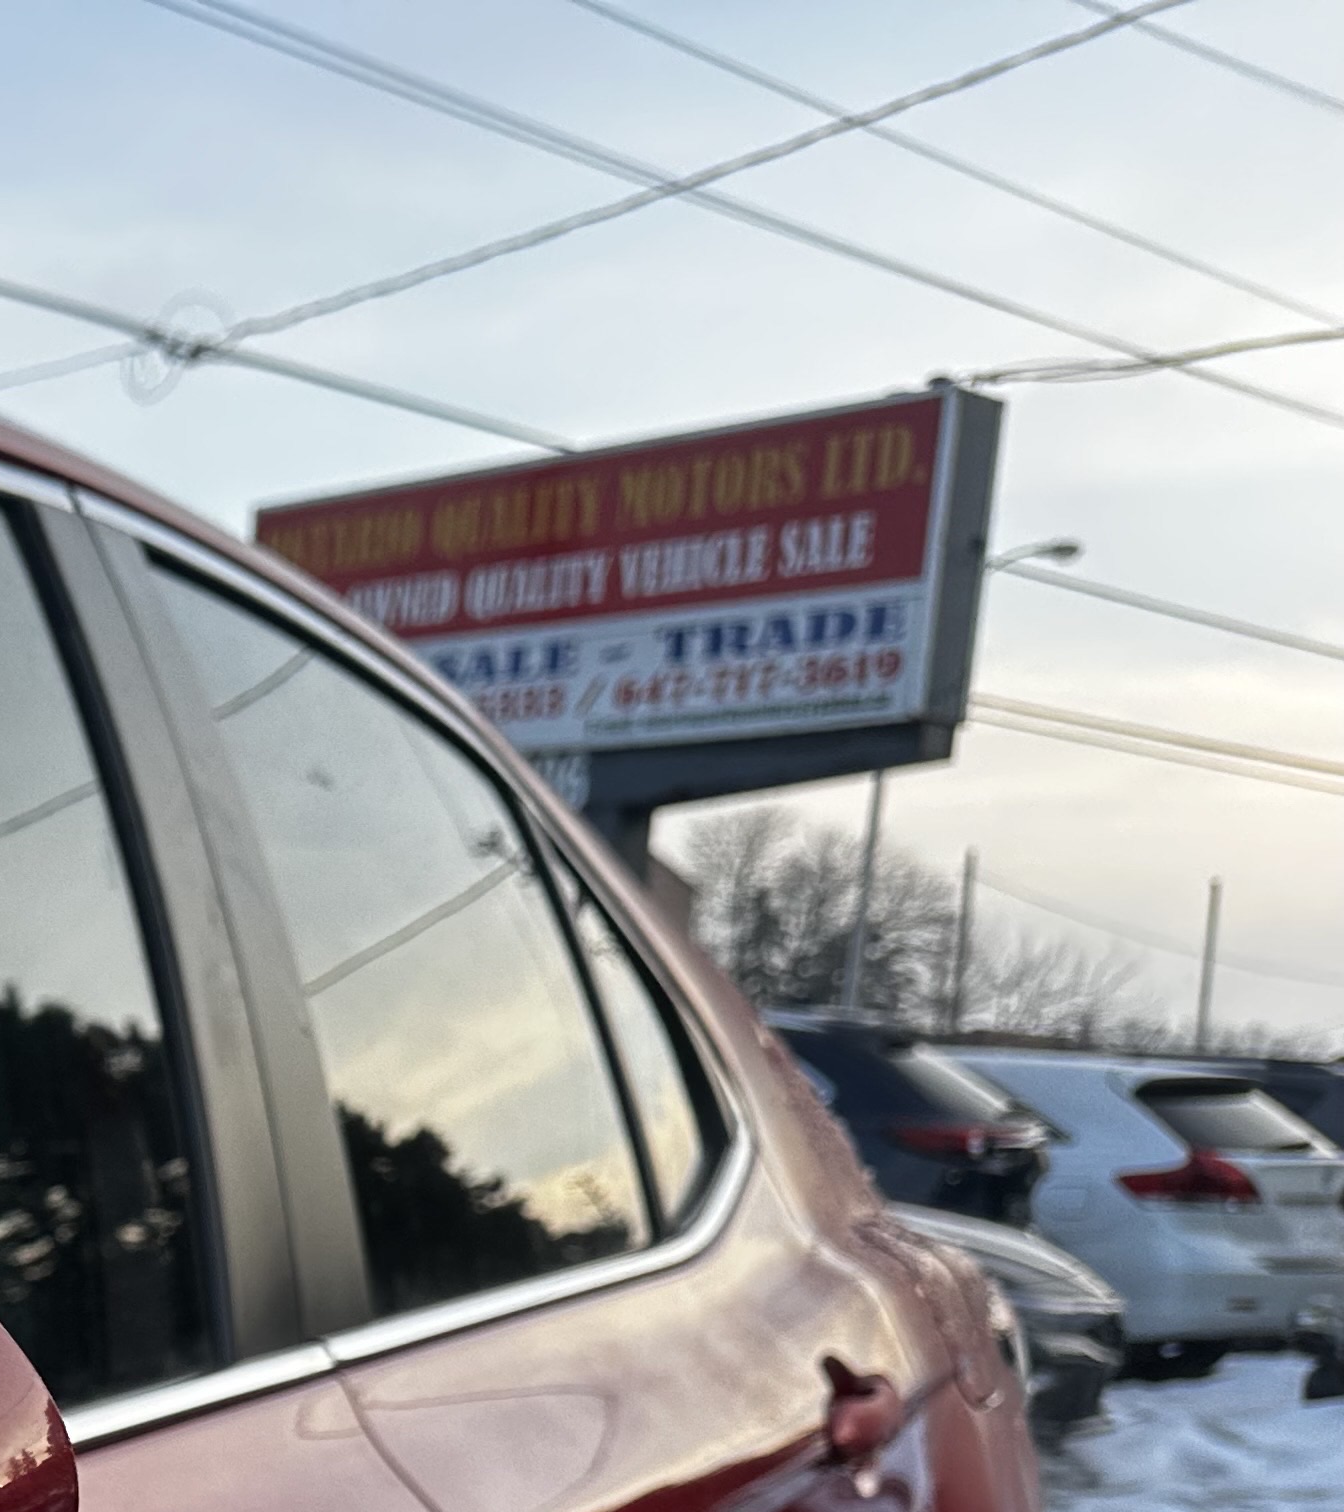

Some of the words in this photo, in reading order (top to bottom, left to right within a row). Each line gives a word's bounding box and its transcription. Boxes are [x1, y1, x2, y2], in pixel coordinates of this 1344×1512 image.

[431, 474, 600, 562] QUALITY
[615, 441, 806, 530] MOTORS
[821, 424, 927, 500] LTD.
[462, 549, 610, 620] QUALITY
[618, 523, 771, 598] VEHICLE
[777, 511, 878, 578] SALE
[657, 600, 909, 664] TRADE
